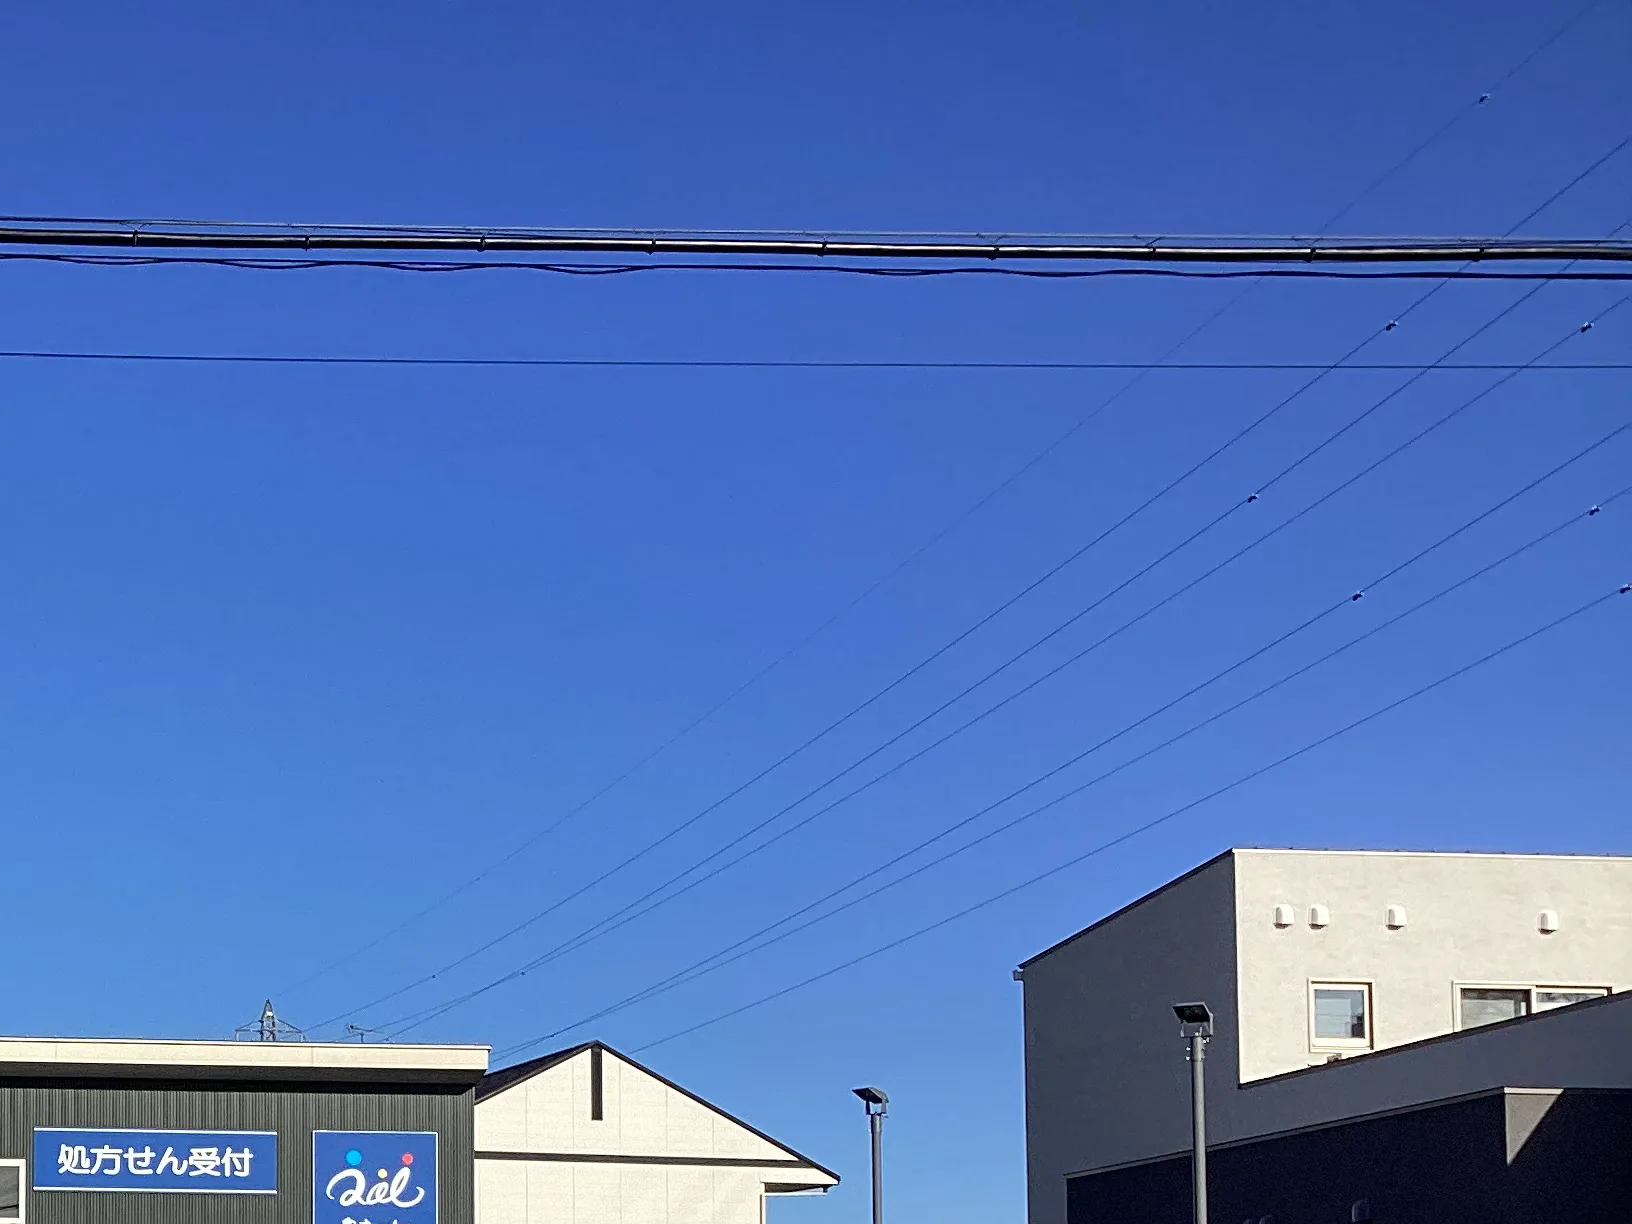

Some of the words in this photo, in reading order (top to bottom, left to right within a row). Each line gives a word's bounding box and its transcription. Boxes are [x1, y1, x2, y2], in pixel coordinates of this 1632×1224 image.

[56, 1143, 255, 1178] 処方せん受付
